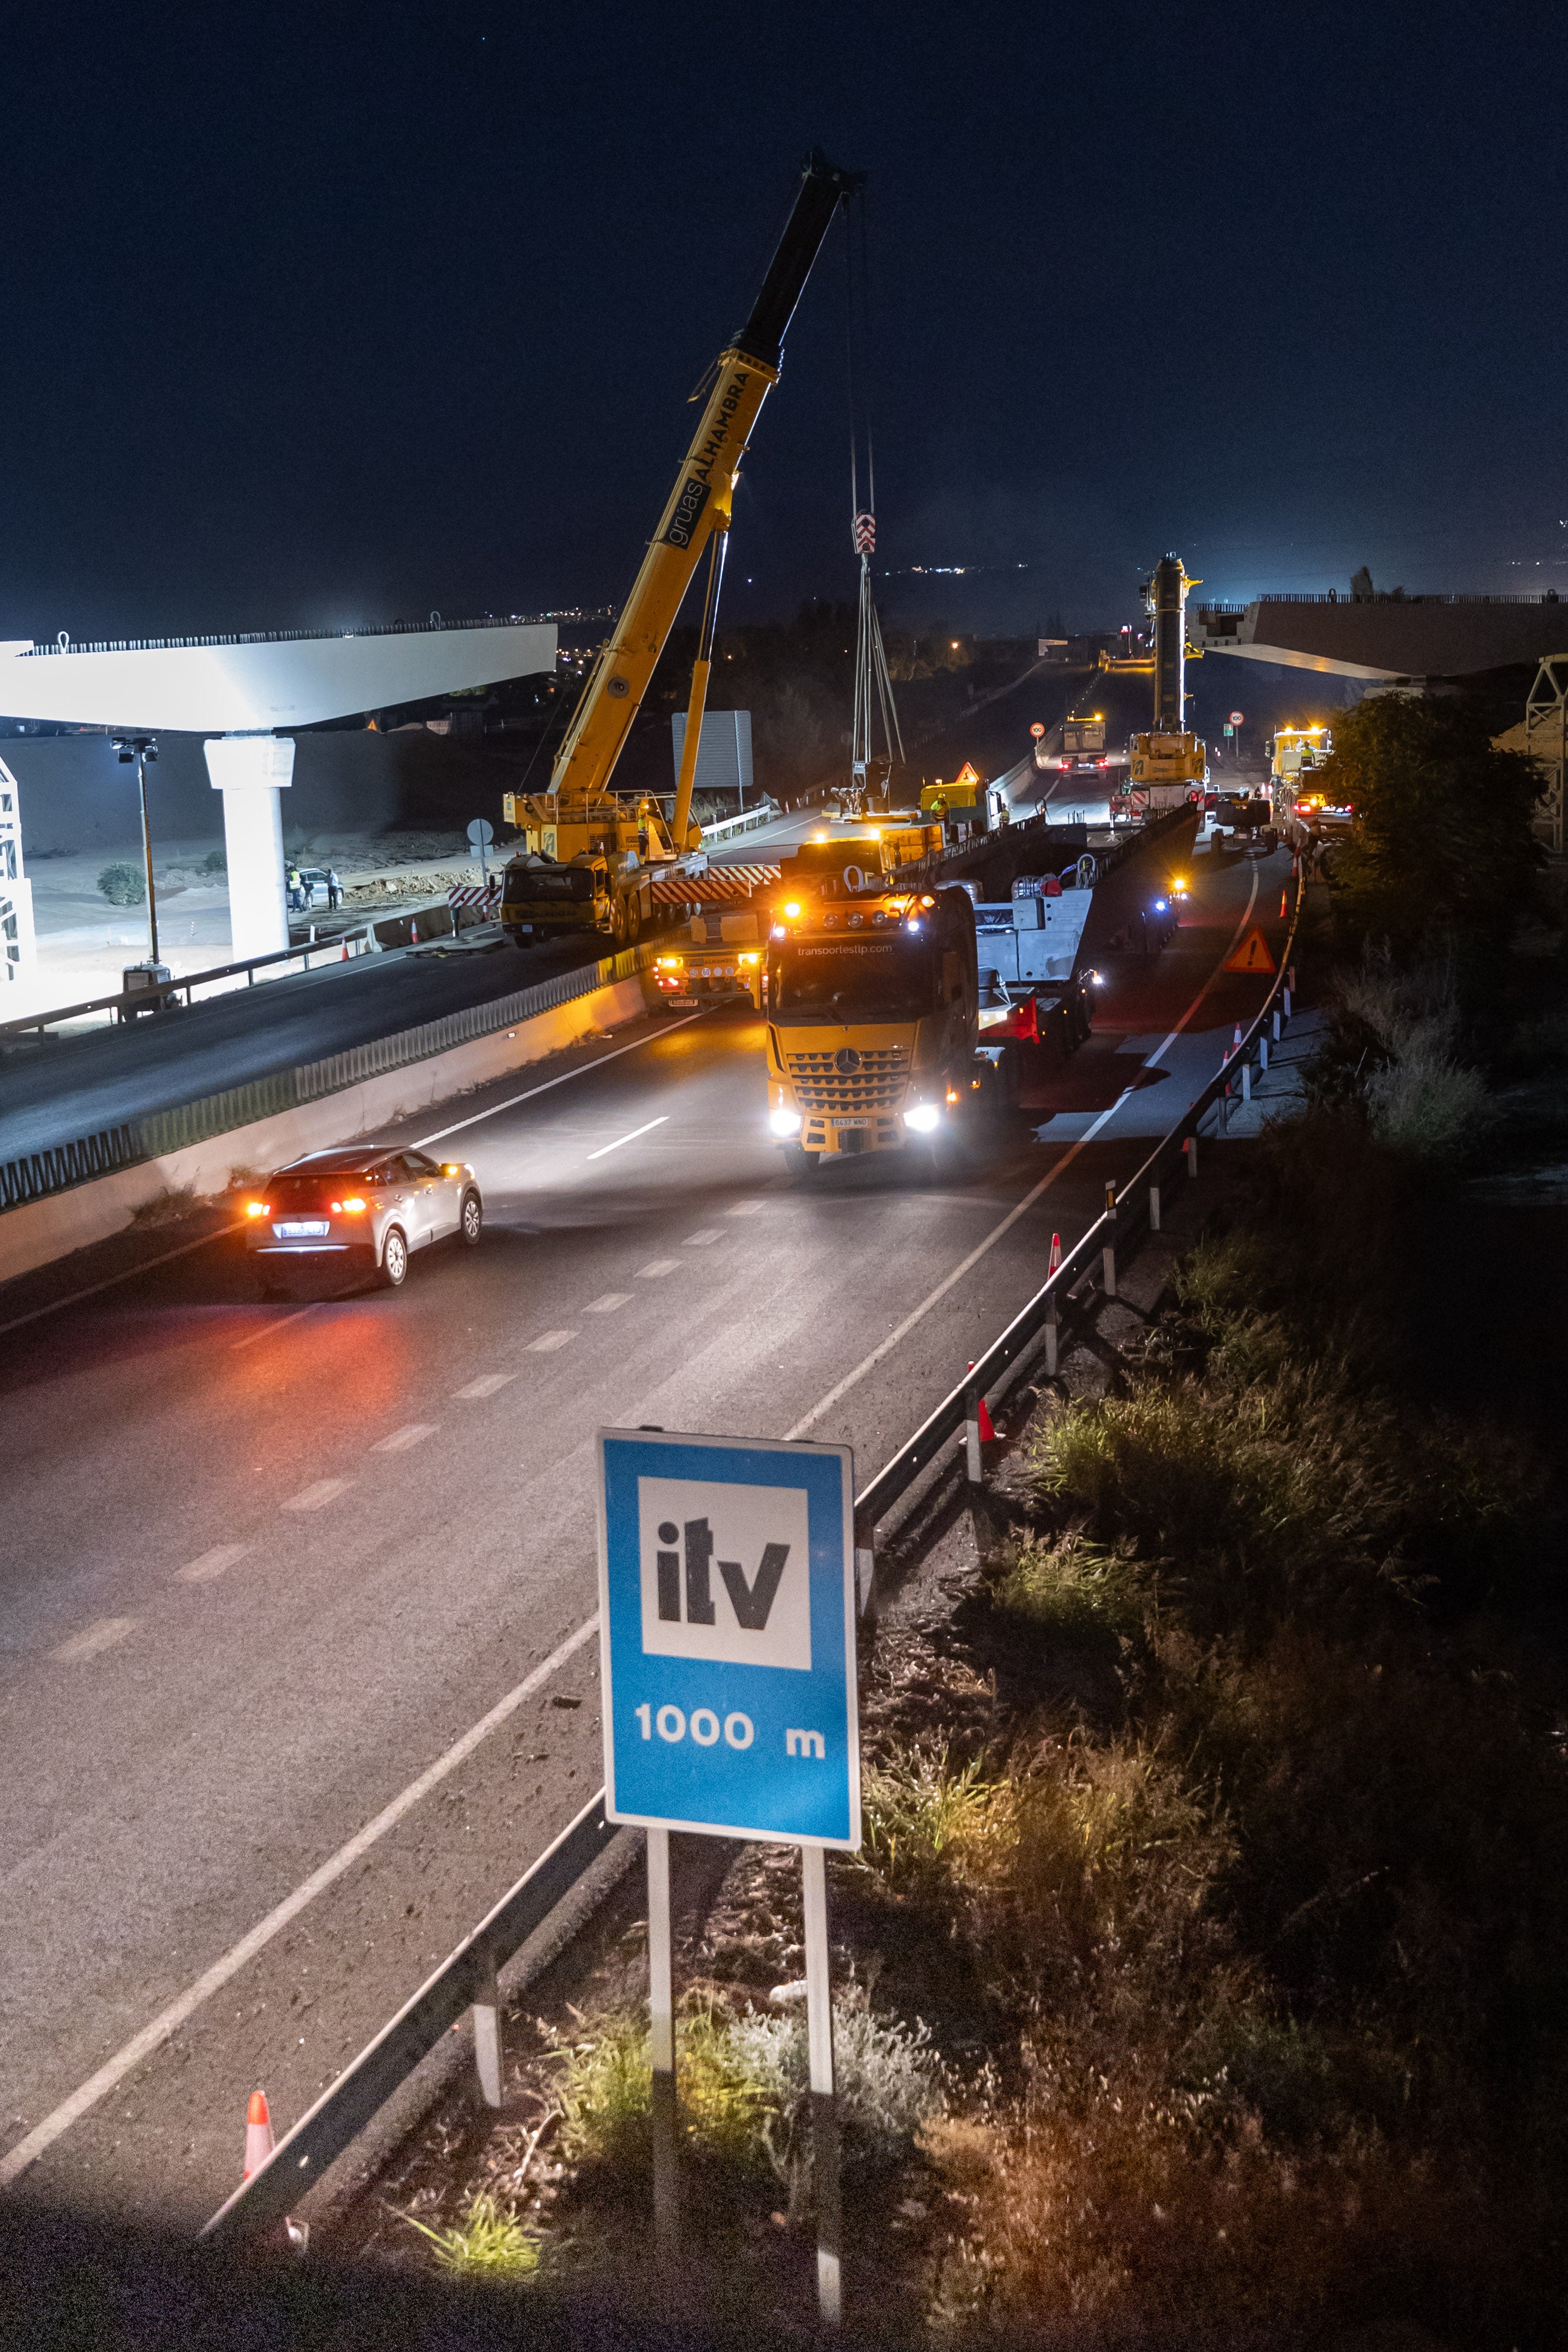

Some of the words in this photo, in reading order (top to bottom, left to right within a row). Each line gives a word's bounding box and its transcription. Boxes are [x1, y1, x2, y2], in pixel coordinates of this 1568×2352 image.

[669, 482, 703, 545] grúas
[694, 373, 750, 485] ALHAMBRA
[656, 1516, 791, 1630] itv
[635, 1703, 754, 1750] 1000
[785, 1728, 825, 1759] m
